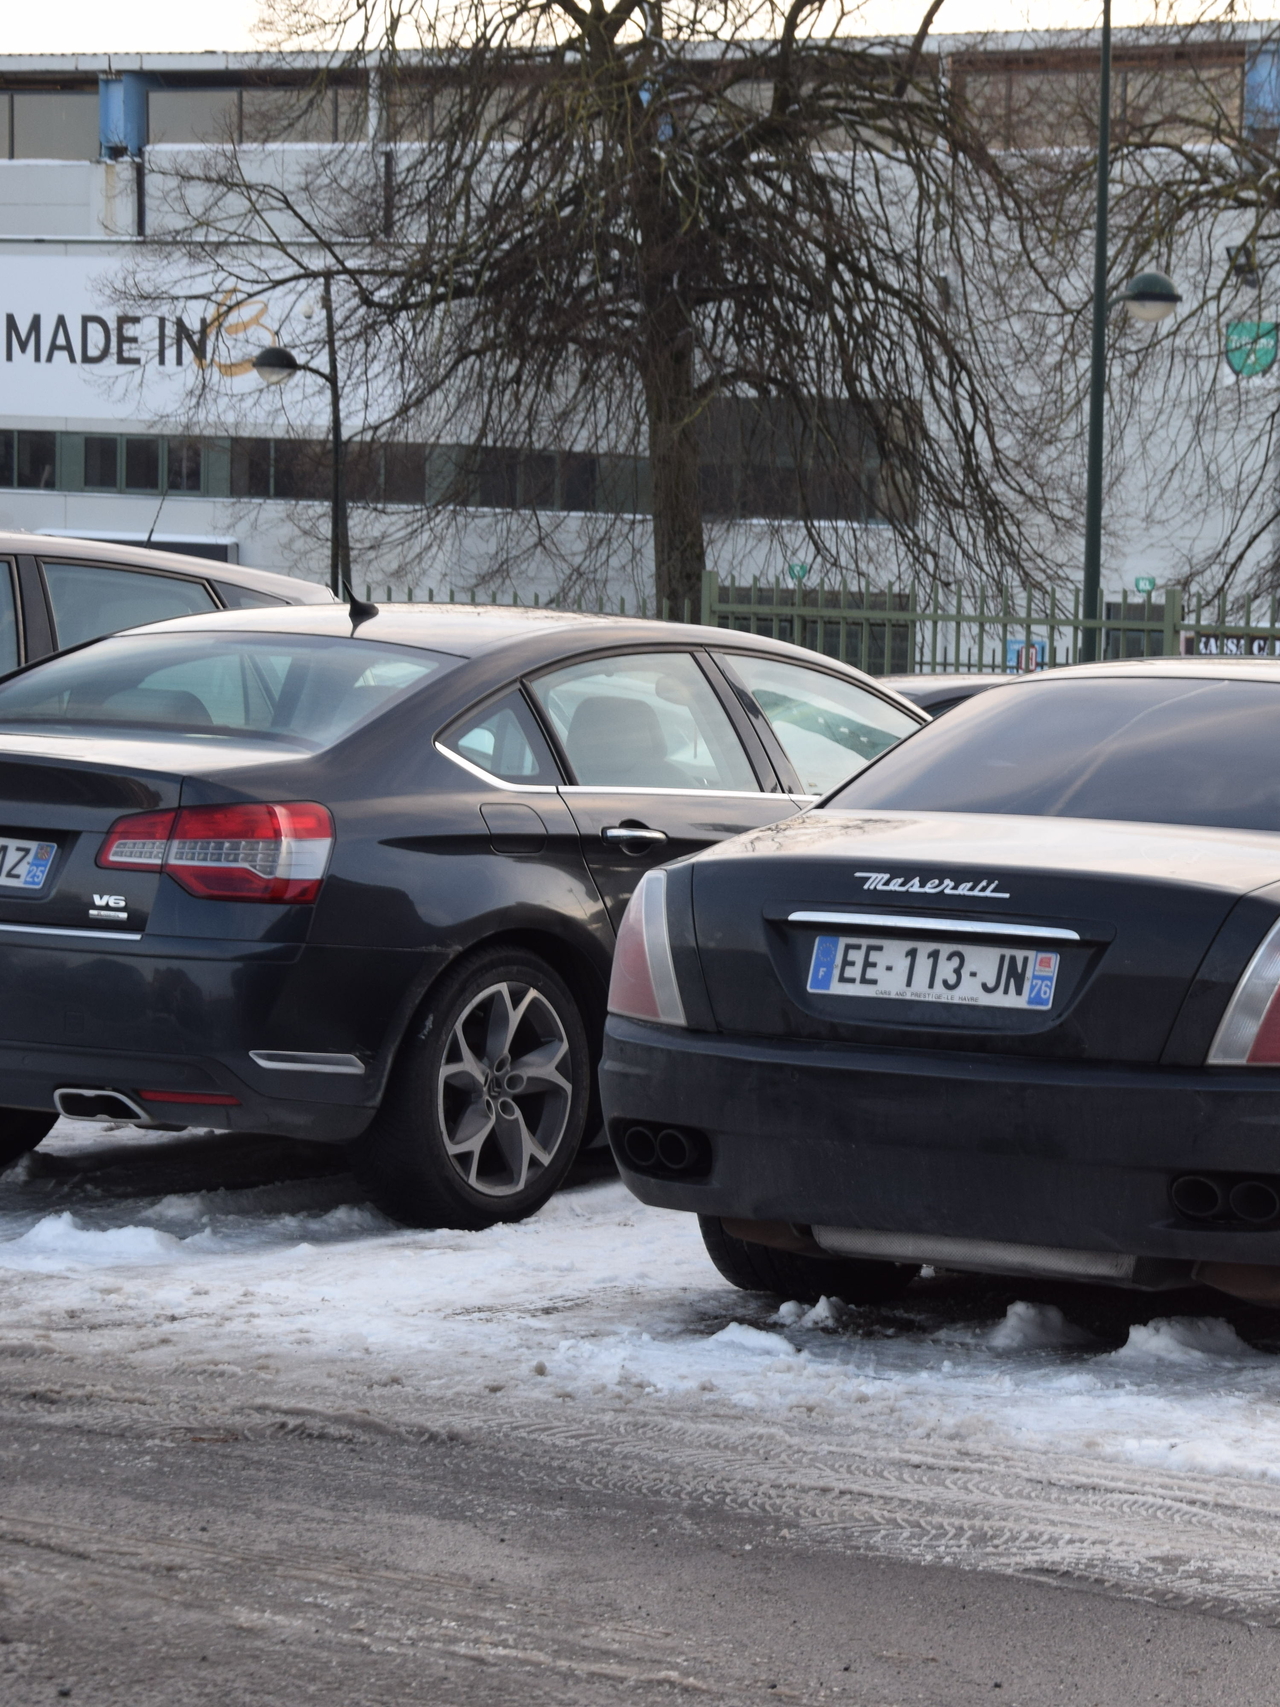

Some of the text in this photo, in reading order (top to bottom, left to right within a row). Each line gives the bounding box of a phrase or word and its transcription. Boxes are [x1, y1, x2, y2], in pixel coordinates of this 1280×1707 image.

[5, 312, 142, 365] MADE
[157, 315, 208, 367] IN
[25, 865, 45, 882] 25
[854, 871, 1010, 898] Maserati
[93, 894, 126, 908] V6
[818, 967, 827, 980] F
[838, 943, 1029, 996] EE-113-JN
[875, 989, 892, 997] CARS
[1030, 979, 1052, 999] 76
